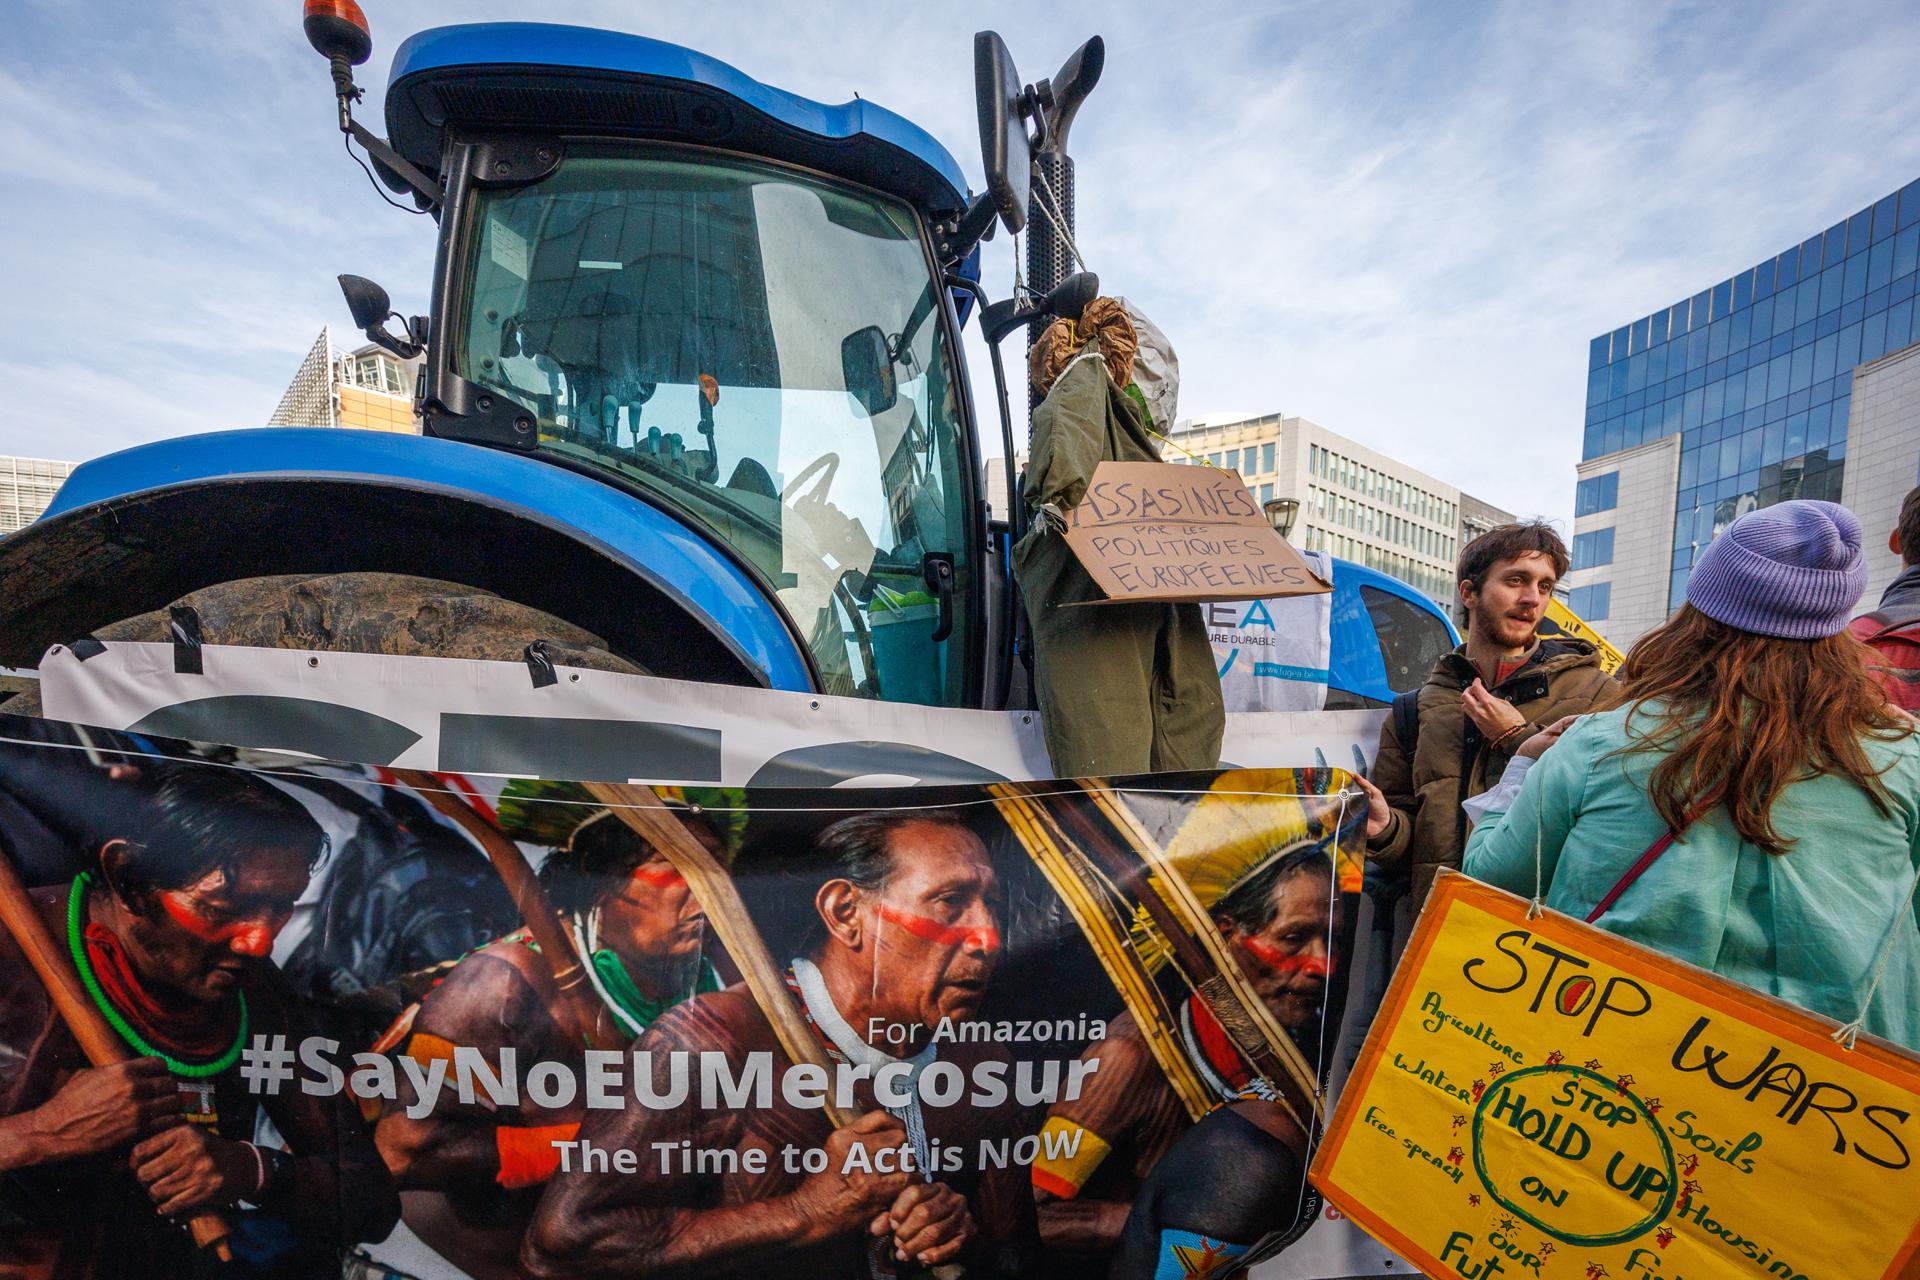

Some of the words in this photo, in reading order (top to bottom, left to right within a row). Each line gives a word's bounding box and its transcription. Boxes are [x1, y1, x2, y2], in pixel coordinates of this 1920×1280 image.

[1092, 537, 1265, 558] POLITIQUES
[1132, 525, 1170, 535] PAR
[1183, 525, 1209, 534] LES
[1109, 561, 1305, 592] EUROPÉENES
[1230, 634, 1276, 647] DURABLE
[868, 1017, 923, 1045] For
[932, 1013, 1107, 1044] Amazonia
[1462, 930, 1653, 1037] STOP
[1670, 1016, 1911, 1170] WARS
[240, 1034, 1100, 1120] #SayNoEUMercosur
[1551, 1080, 1637, 1128] STOP
[550, 1140, 638, 1174] The
[651, 1142, 767, 1175] Time
[781, 1144, 829, 1174] to
[841, 1141, 916, 1174] Act
[930, 1138, 963, 1172] is
[978, 1128, 1083, 1171] NOW
[1491, 1086, 1591, 1160] HOLD
[1605, 1151, 1668, 1201] UP
[1520, 1176, 1569, 1208] ON
[1677, 1194, 1809, 1280] Housin
